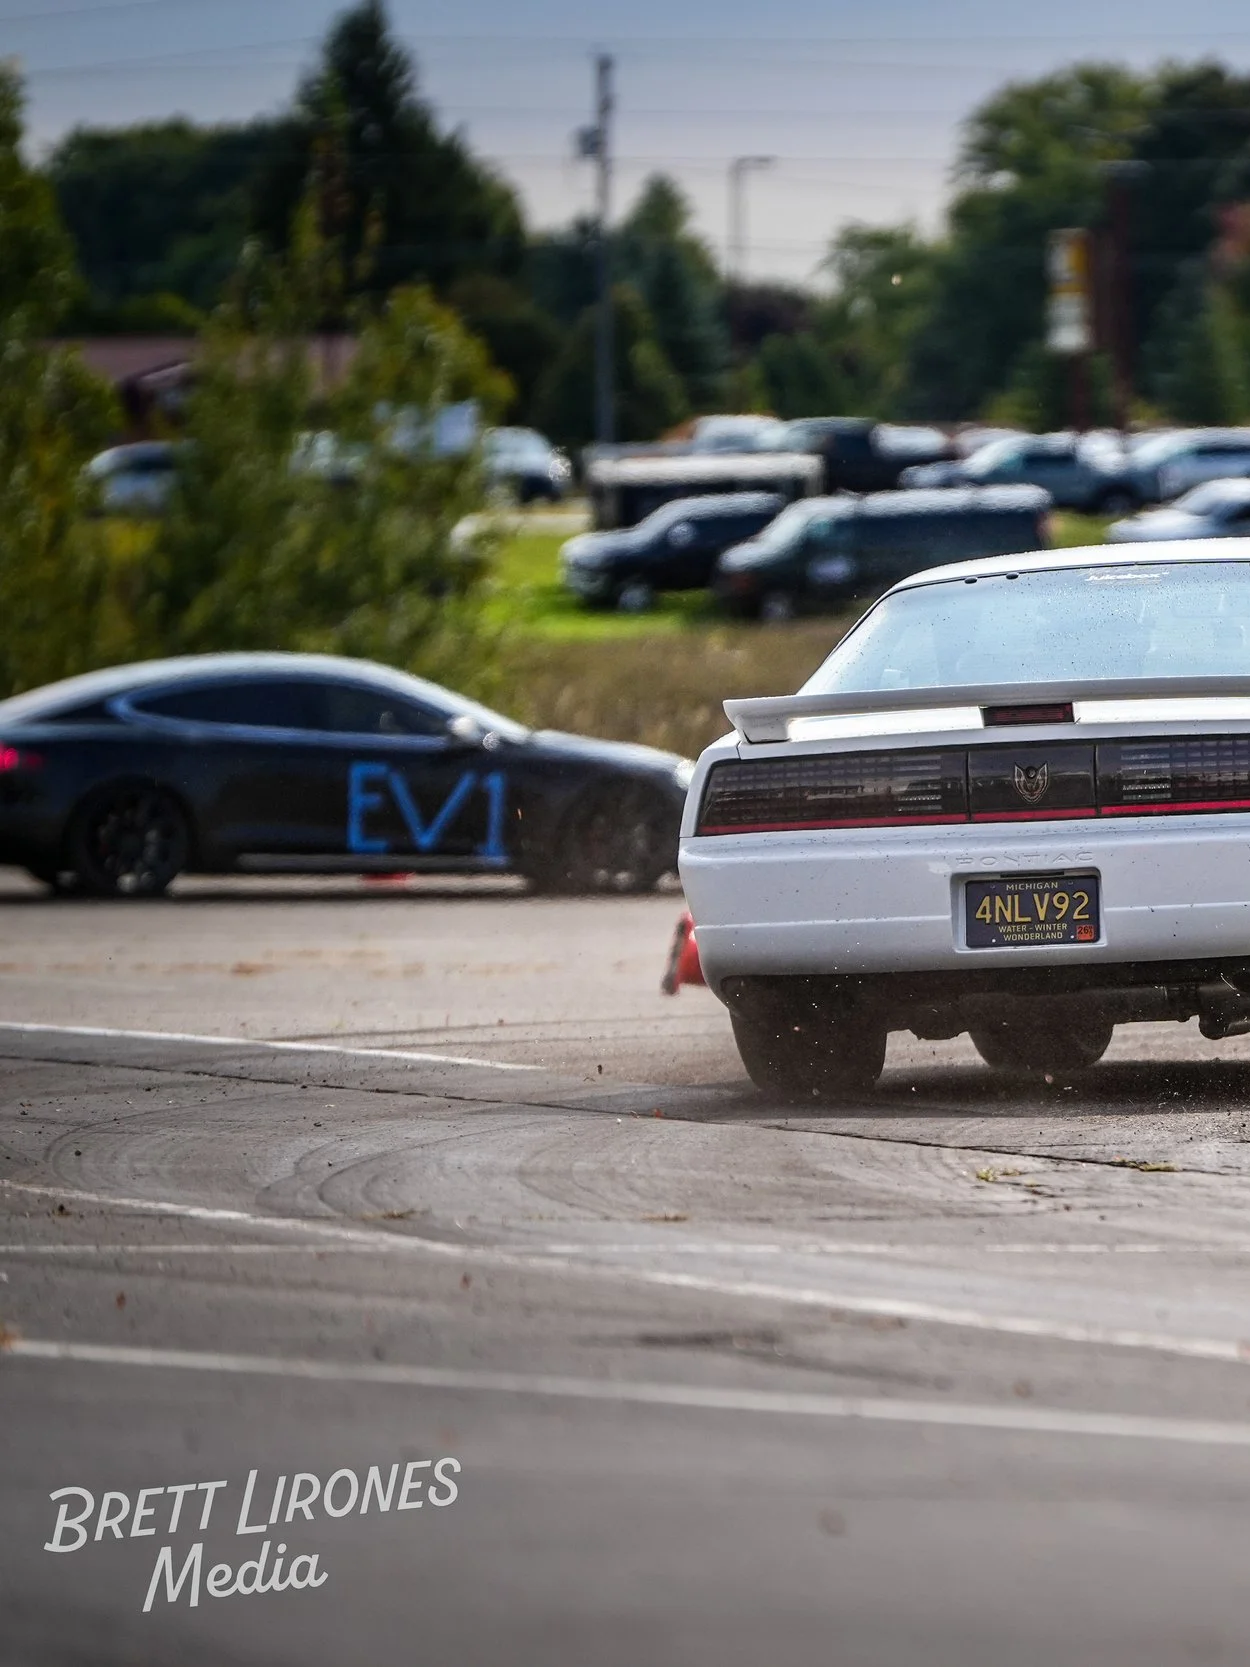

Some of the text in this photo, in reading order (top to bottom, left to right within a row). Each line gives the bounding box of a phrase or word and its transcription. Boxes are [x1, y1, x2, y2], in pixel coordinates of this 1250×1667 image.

[347, 761, 510, 866] EV1
[1006, 881, 1058, 891] MICHIGAN
[975, 891, 1090, 924] 4NLV92
[998, 924, 1027, 933] WATER
[1035, 922, 1068, 931] WINTER
[1003, 931, 1063, 941] WONDERLAND
